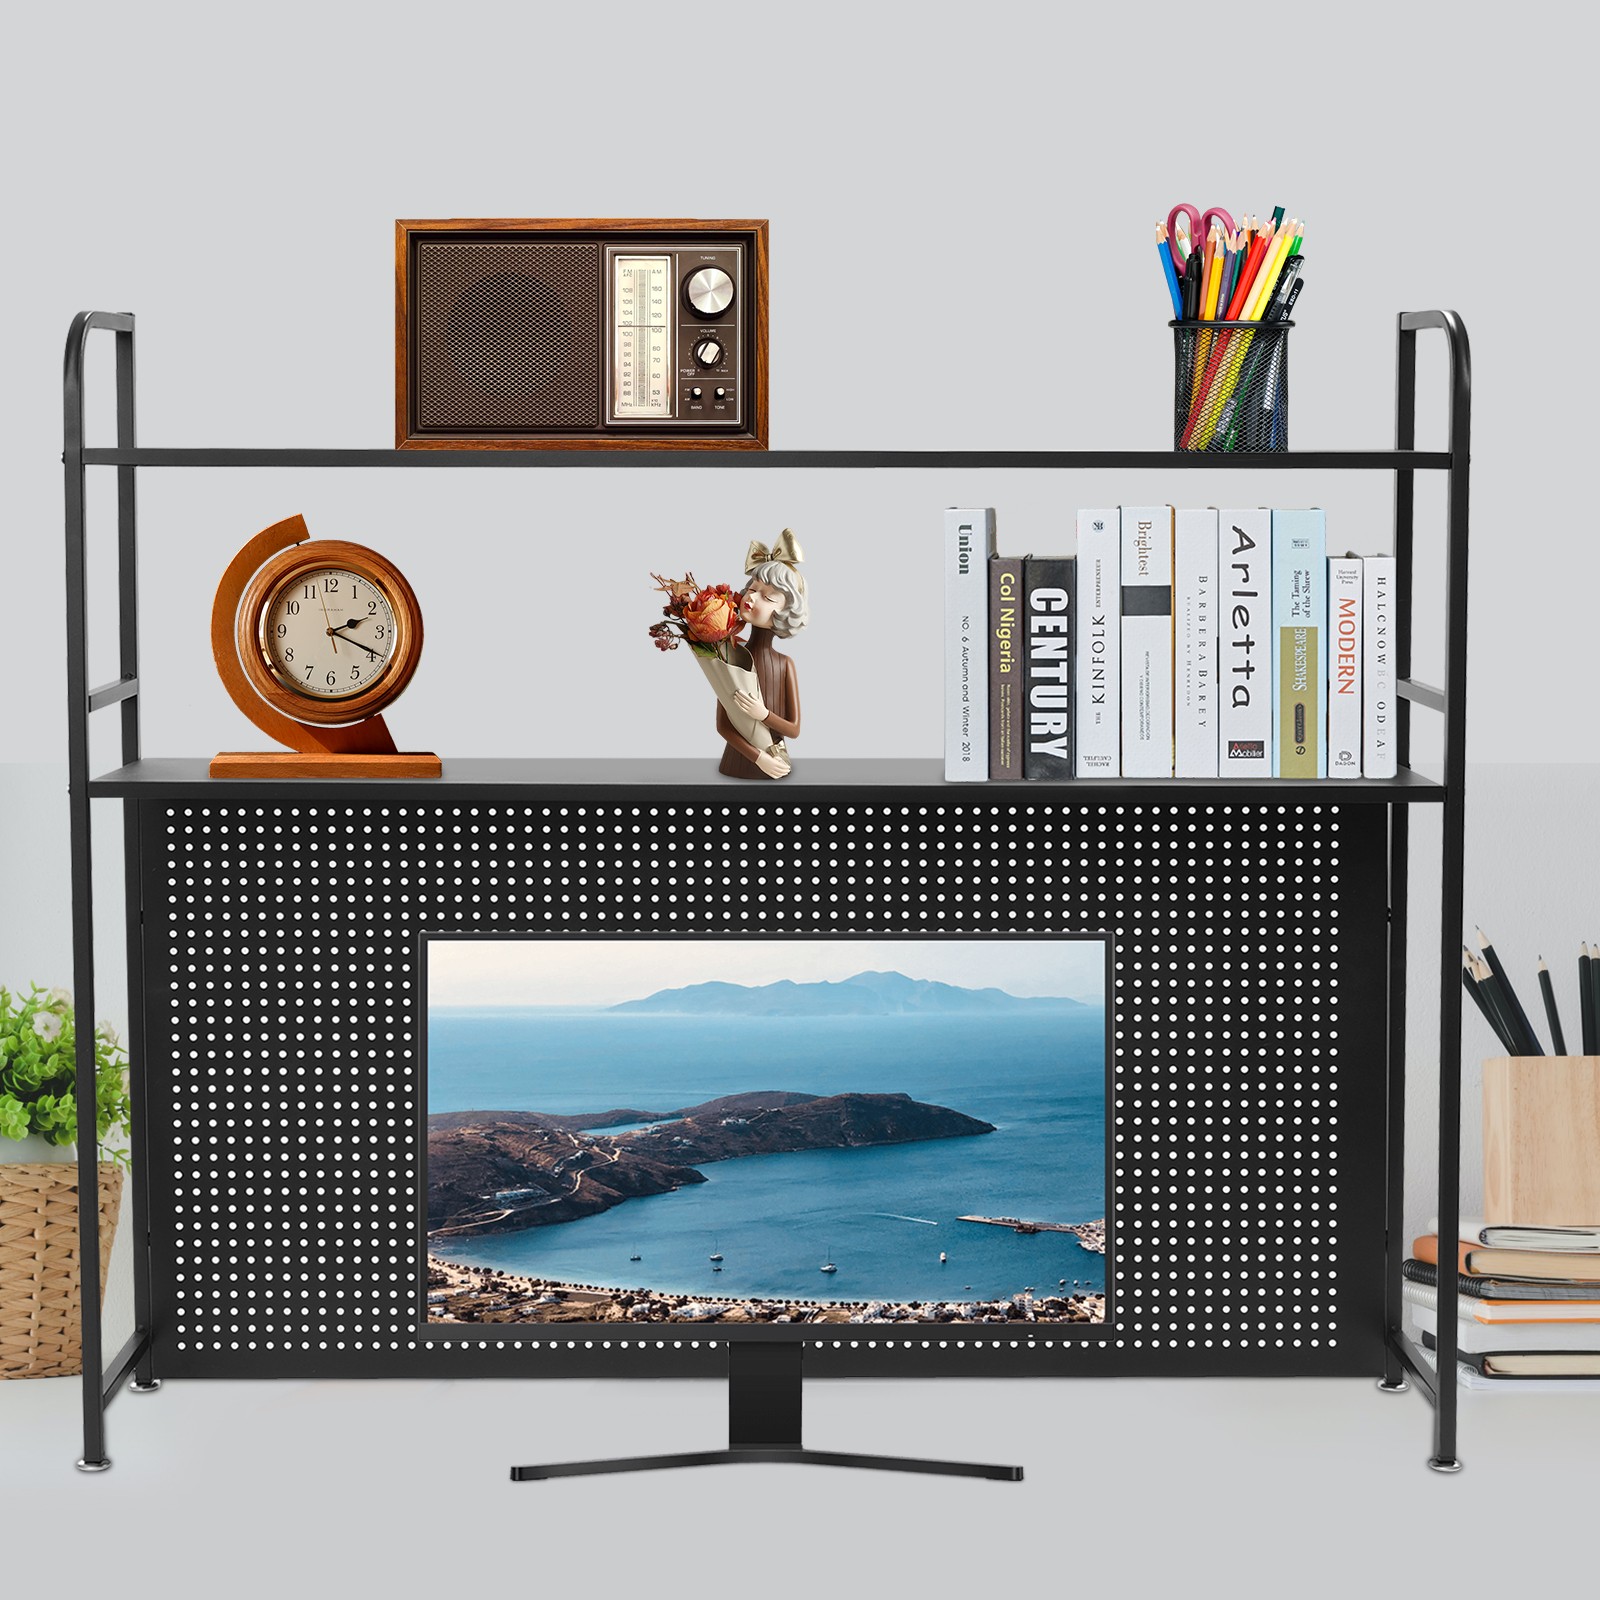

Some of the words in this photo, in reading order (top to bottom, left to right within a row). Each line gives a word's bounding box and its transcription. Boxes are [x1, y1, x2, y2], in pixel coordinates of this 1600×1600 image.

[958, 524, 972, 574] Union
[1134, 521, 1152, 576] Brightest
[324, 578, 339, 593] 12
[1000, 573, 1015, 601] Col
[1292, 570, 1302, 599] Taming
[1302, 570, 1311, 594] Shrew
[304, 585, 316, 599] 11
[352, 585, 358, 599] 1
[286, 601, 300, 615] 10
[368, 601, 377, 615] 2
[1292, 601, 1300, 618] The
[1302, 596, 1310, 608] the
[1232, 526, 1258, 708] Arletta
[1302, 609, 1310, 618] of
[277, 624, 286, 638] 9
[374, 625, 384, 639] 3
[996, 608, 1015, 673] Nigeria
[1338, 598, 1356, 694] MODERN
[284, 648, 294, 662] 8
[365, 648, 377, 662] 4
[1092, 615, 1105, 704] KINFOLK
[1292, 628, 1307, 691] SHAKESPEARE
[304, 665, 314, 680] 7
[350, 665, 360, 680] 5
[962, 646, 970, 682] Autumn
[326, 671, 336, 686] 6
[1030, 588, 1068, 759] CENTURY
[962, 684, 970, 702] and
[962, 706, 970, 737] Winter
[962, 742, 970, 762] 2018
